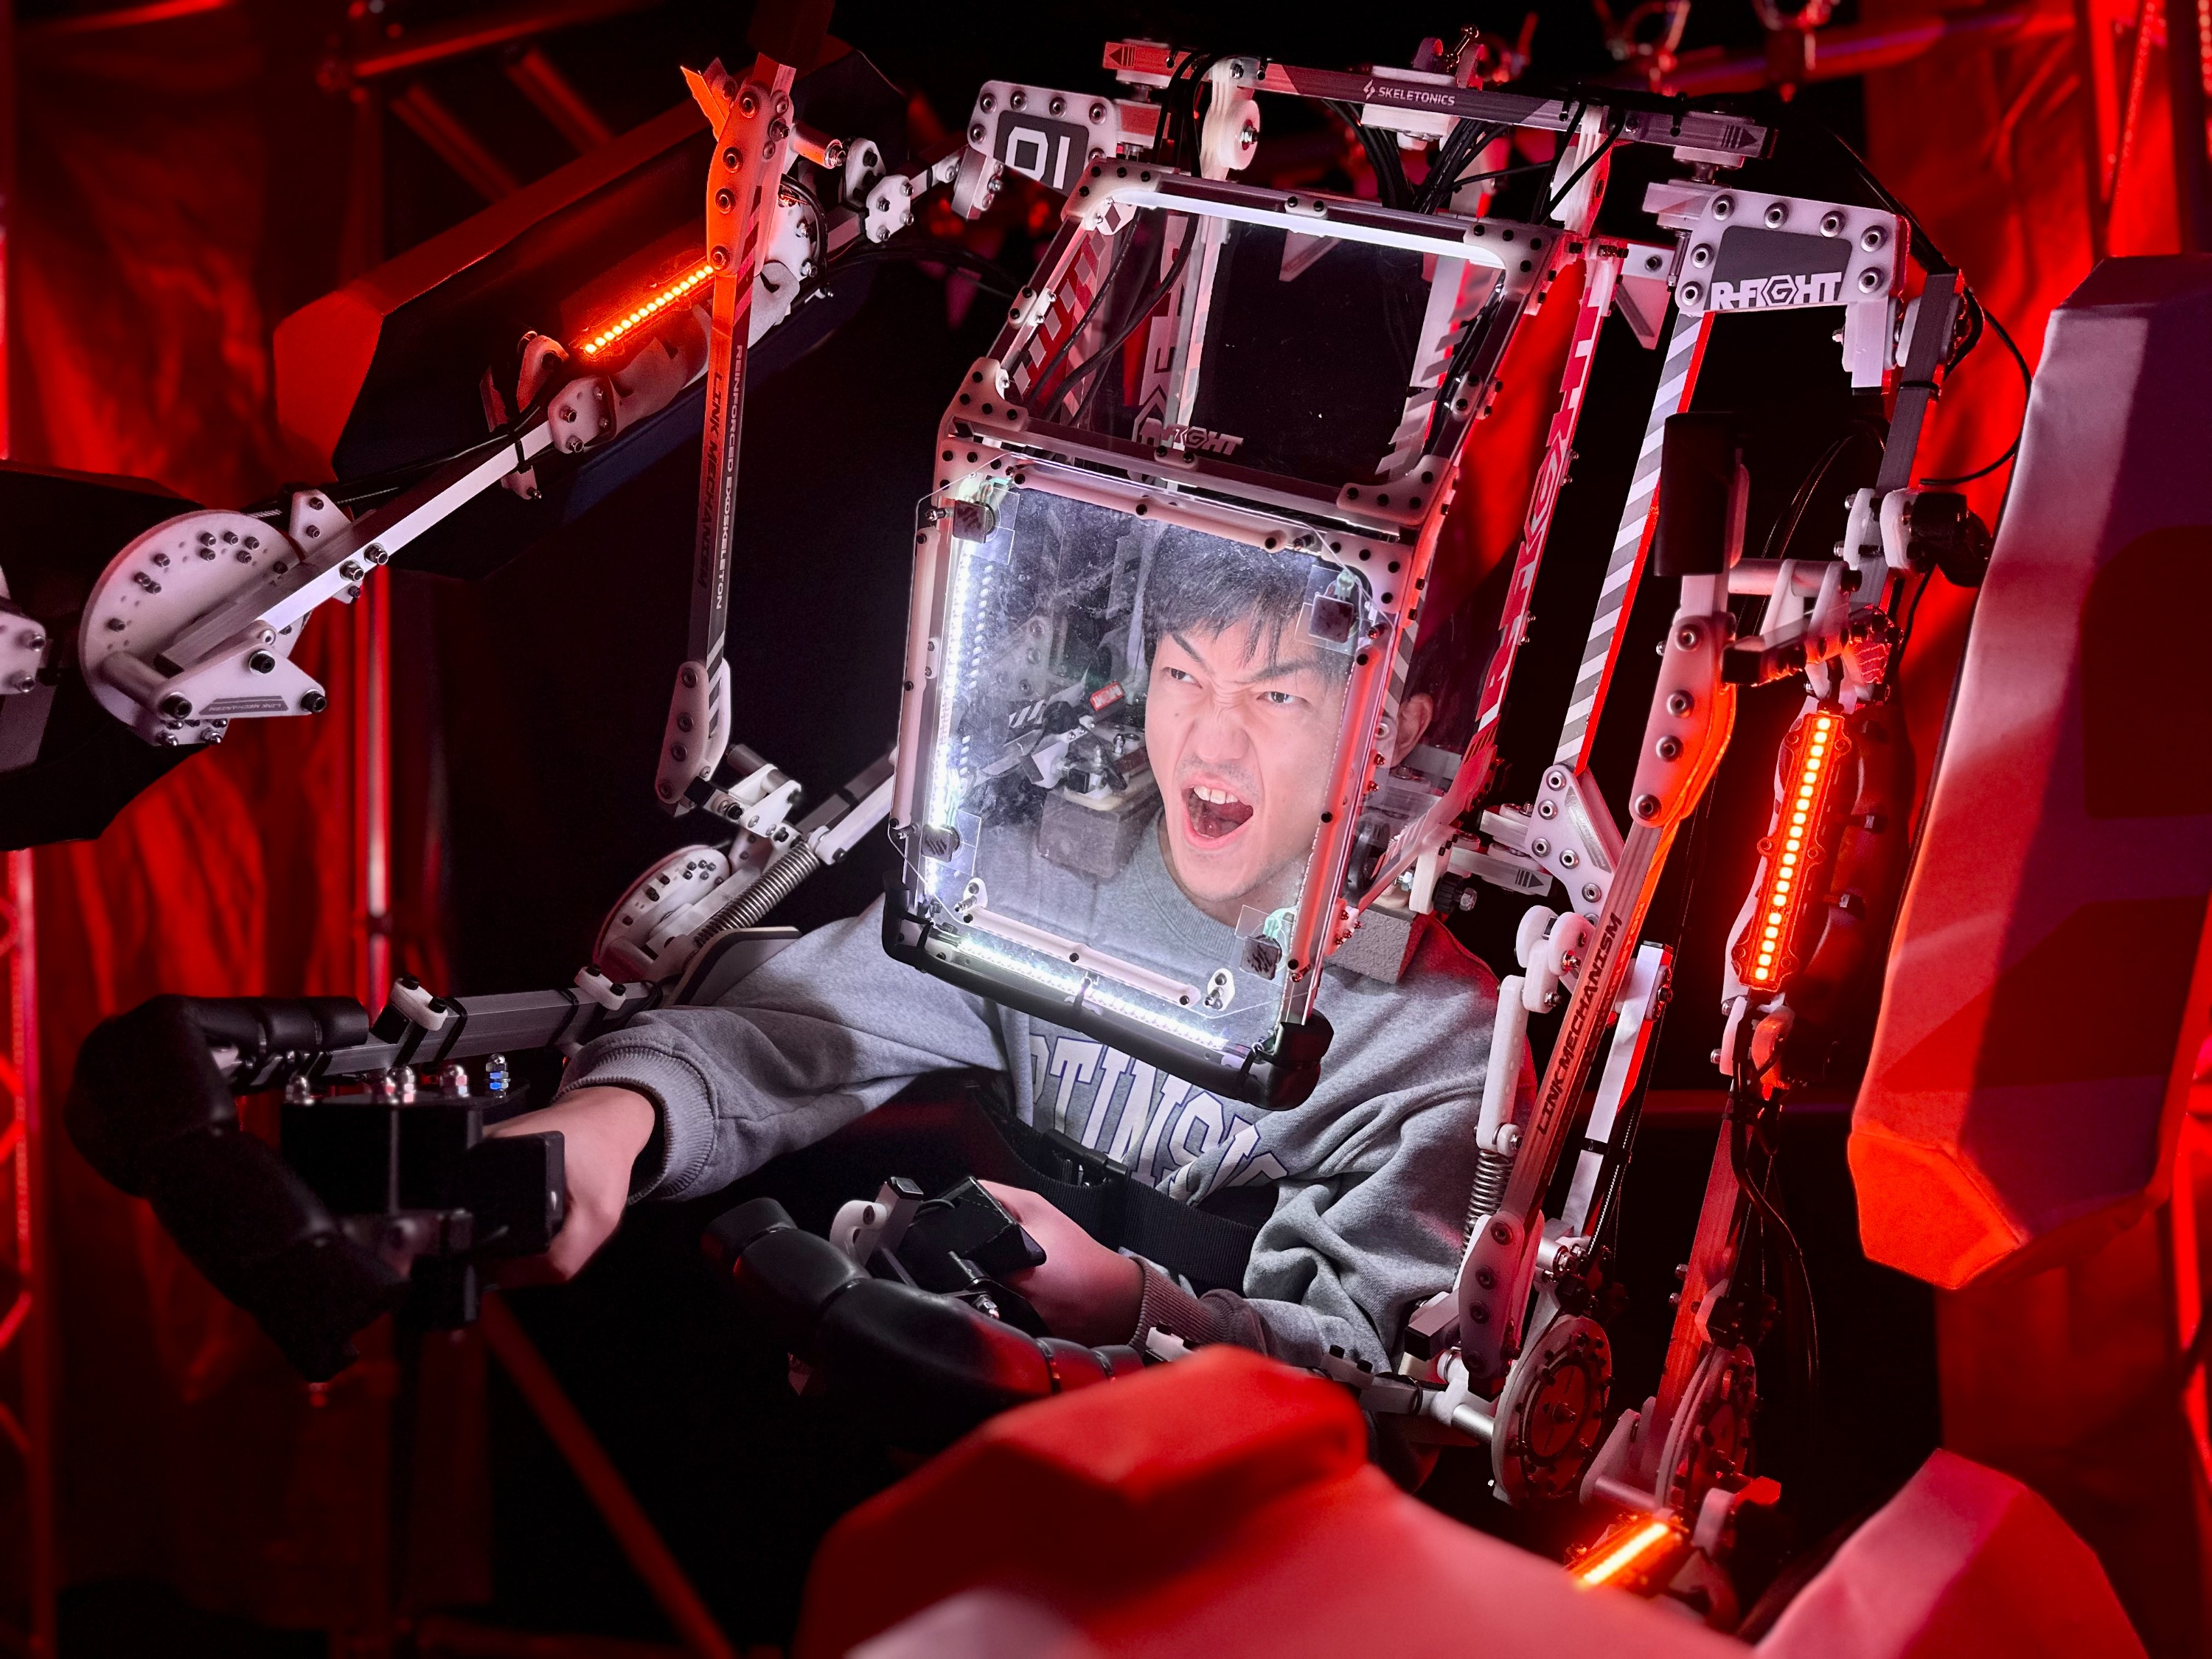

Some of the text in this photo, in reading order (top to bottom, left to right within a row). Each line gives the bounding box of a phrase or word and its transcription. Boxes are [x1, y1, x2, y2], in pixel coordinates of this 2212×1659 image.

[1378, 86, 1455, 106] SKELETONICS
[696, 372, 723, 589] LINK MECHANISM
[716, 344, 742, 610] REINFORCED EXOSKELETON
[1536, 1069, 1564, 1135] LINK
[1558, 911, 1623, 1068] MECHANISM
